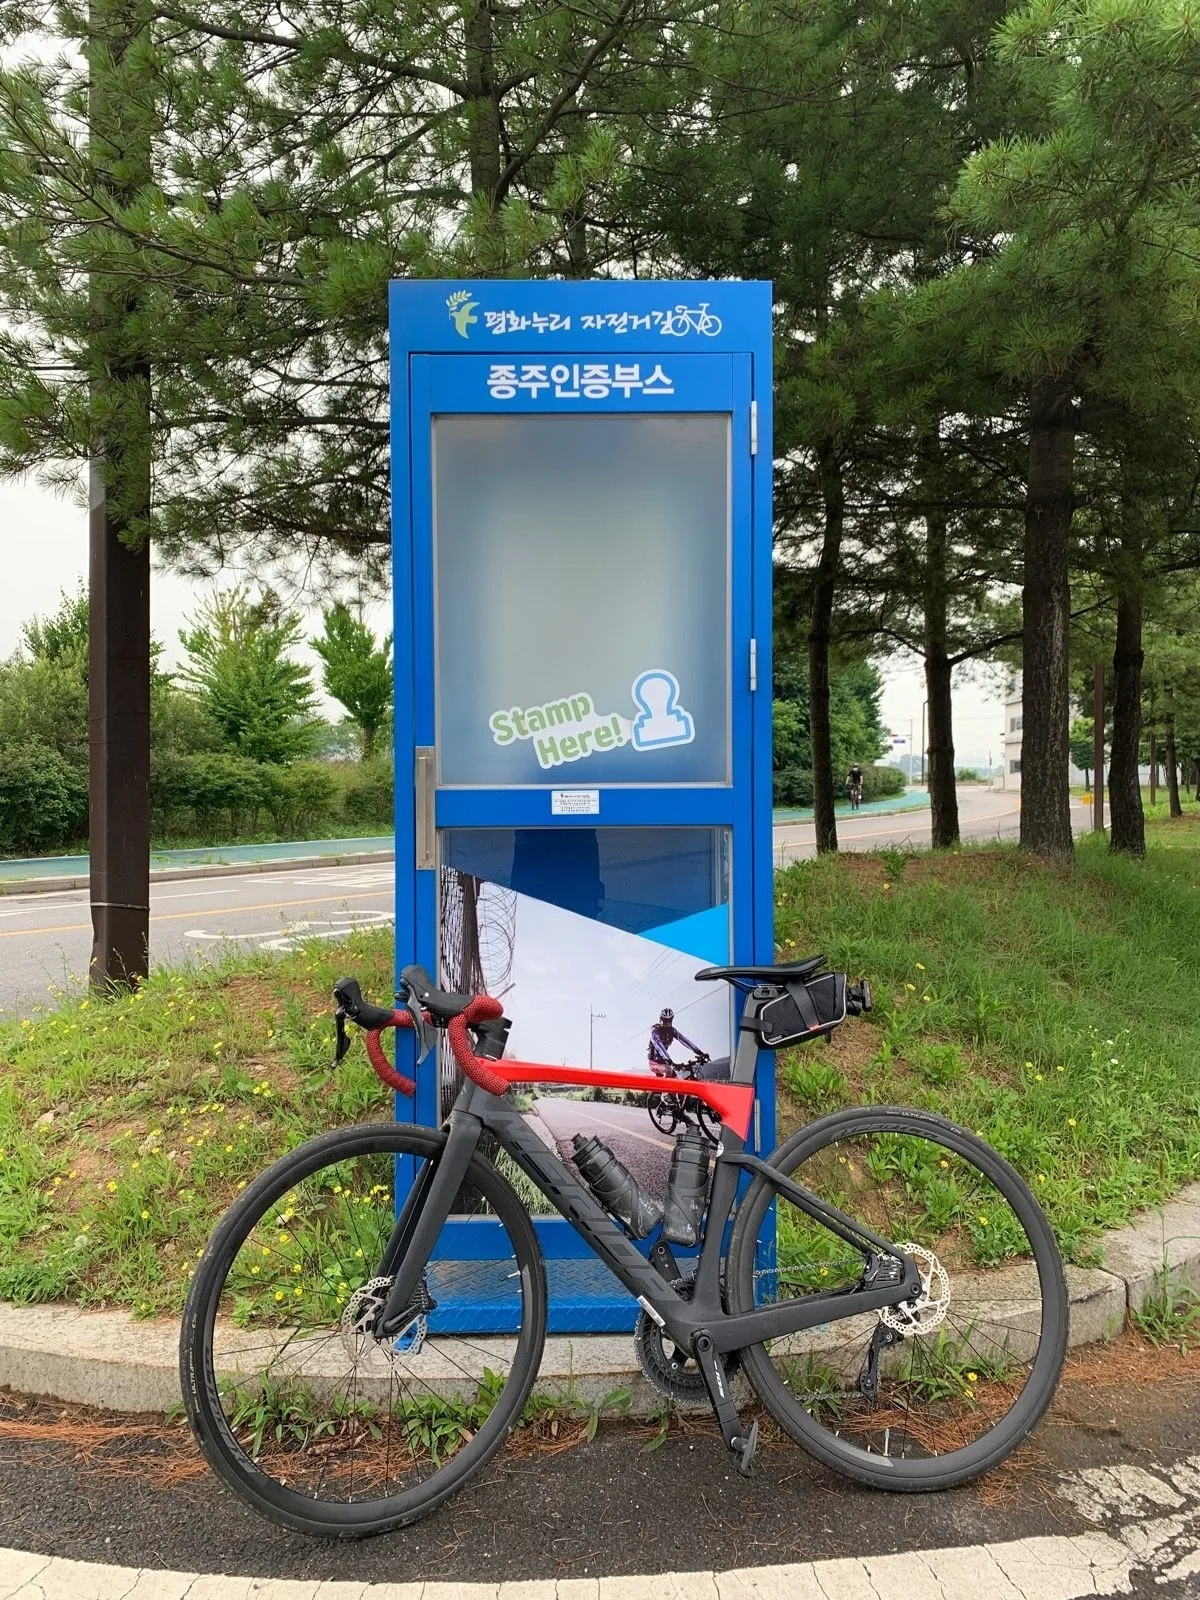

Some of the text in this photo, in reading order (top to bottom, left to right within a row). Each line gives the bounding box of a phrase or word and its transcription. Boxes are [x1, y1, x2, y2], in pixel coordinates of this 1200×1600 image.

[484, 310, 673, 335] 평화누리 자전거길
[487, 363, 675, 400] 종주인증부스
[492, 696, 592, 742] Stamp
[537, 716, 624, 765] Here!
